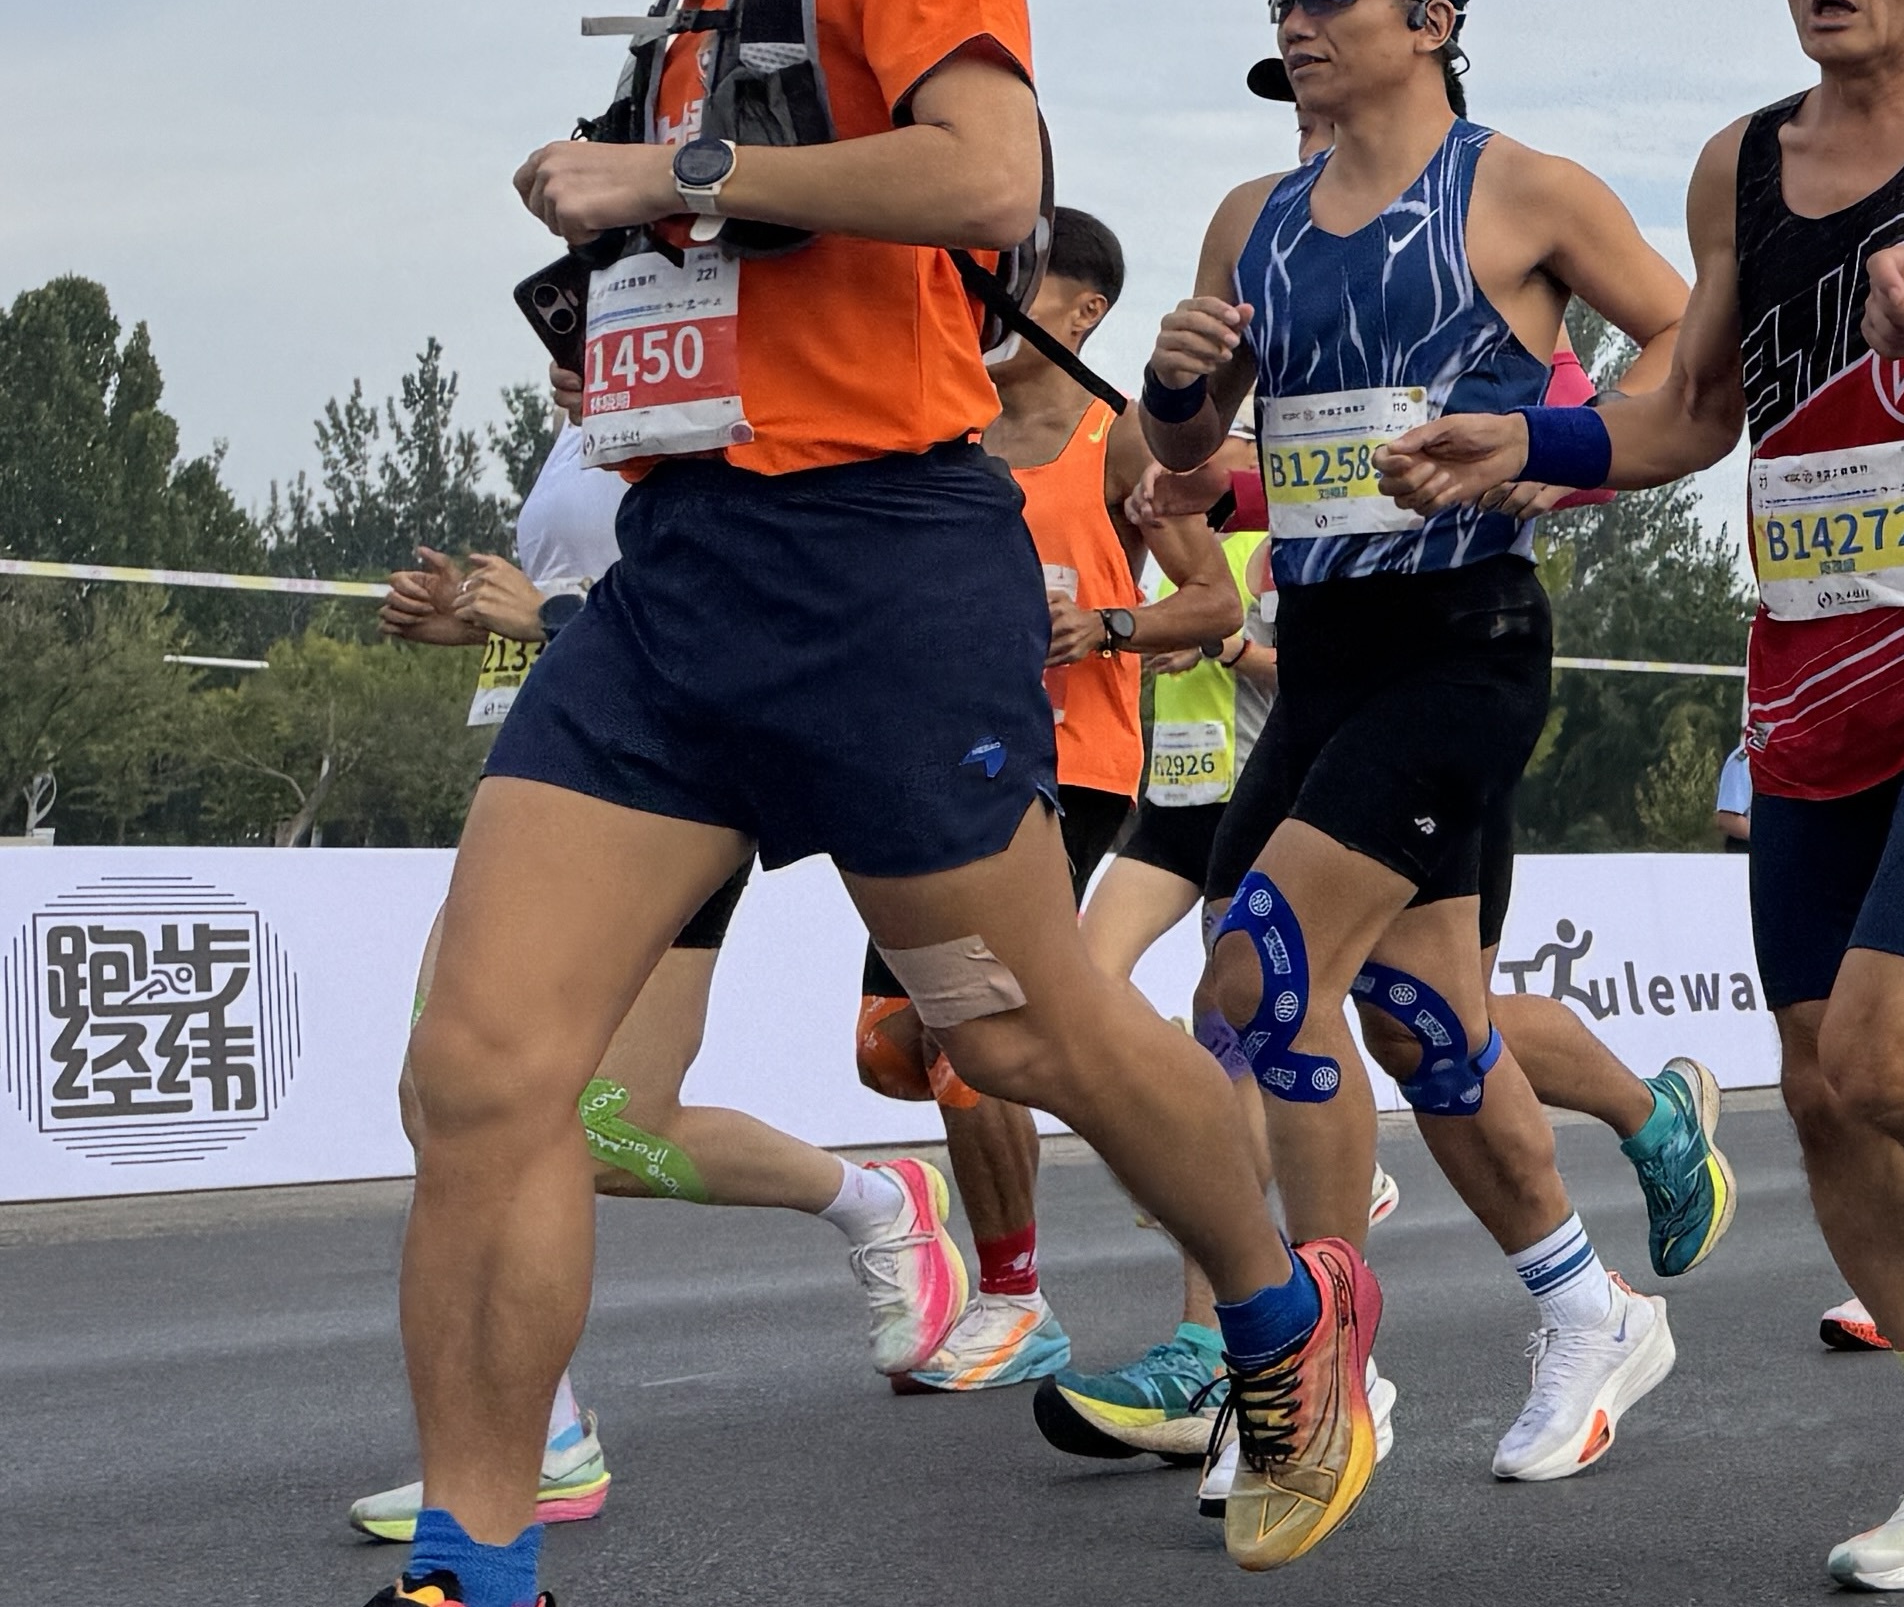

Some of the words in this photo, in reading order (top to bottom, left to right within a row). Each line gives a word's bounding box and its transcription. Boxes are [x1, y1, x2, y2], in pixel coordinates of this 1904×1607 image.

[588, 324, 704, 393] 1450
[46, 923, 252, 1018] 跑步
[48, 1021, 257, 1119] 经纬
